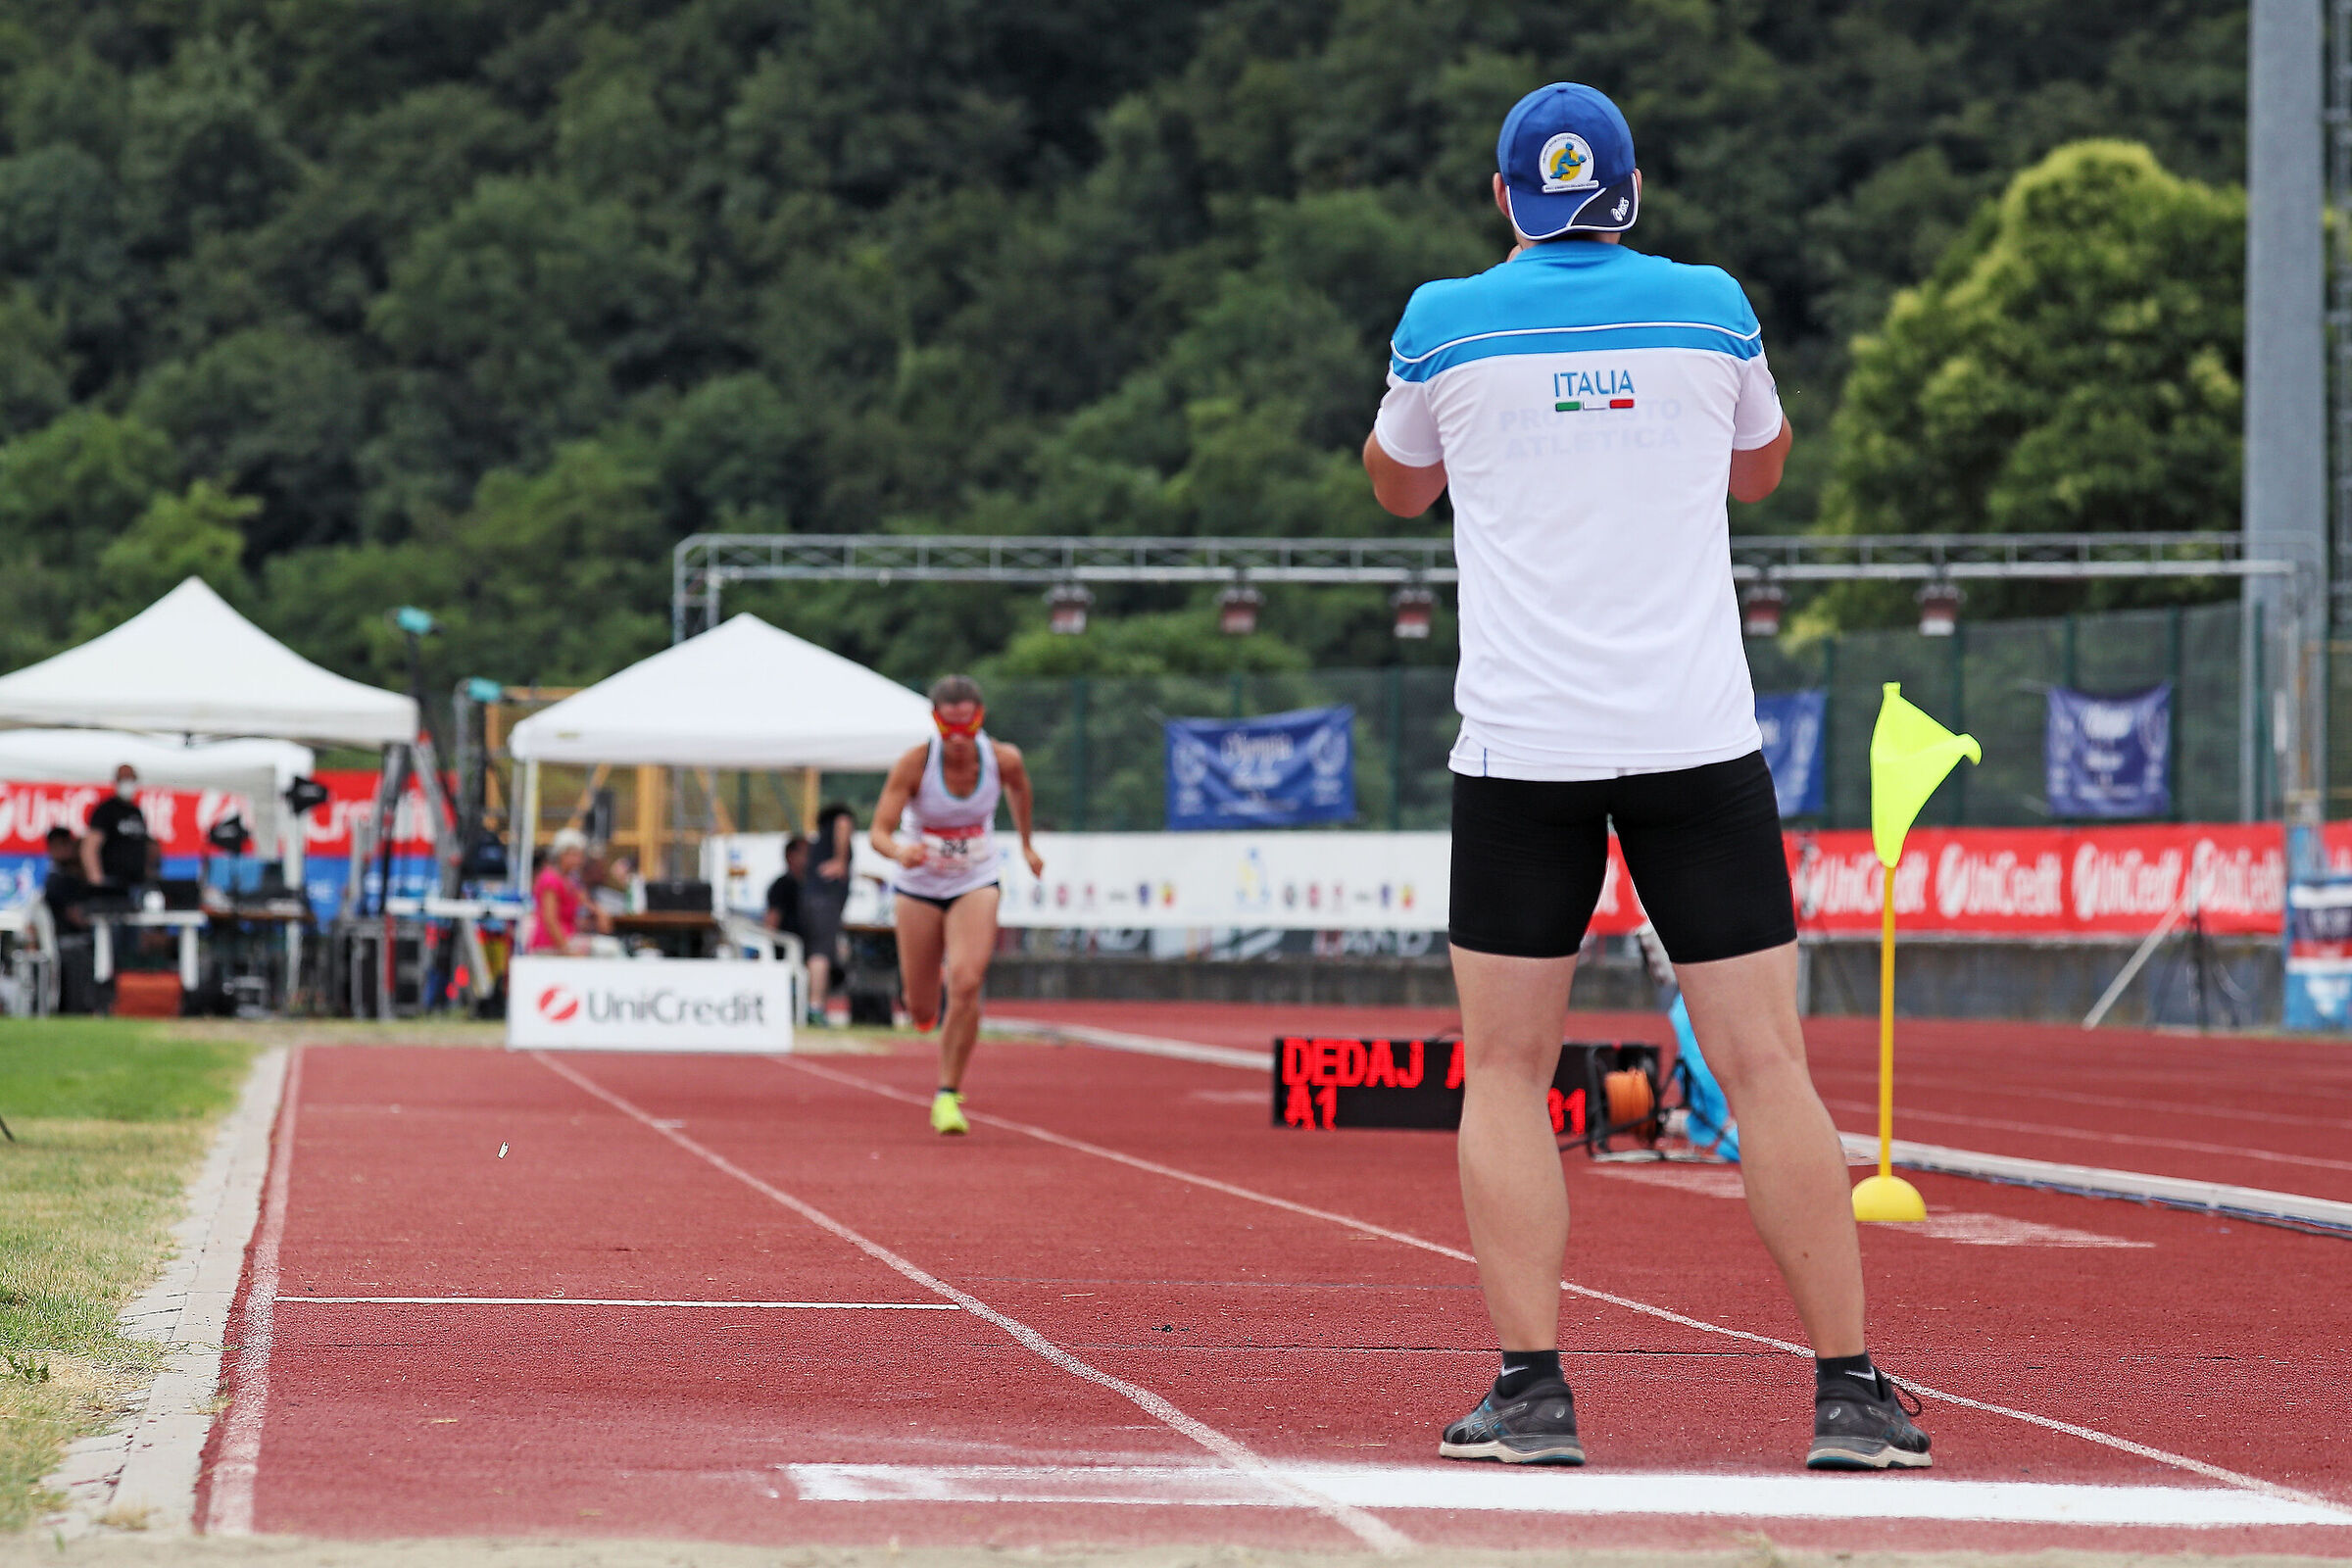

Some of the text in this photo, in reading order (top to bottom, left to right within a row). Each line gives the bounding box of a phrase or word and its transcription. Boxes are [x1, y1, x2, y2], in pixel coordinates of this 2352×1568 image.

[1553, 369, 1636, 398] ITALIA
[588, 988, 765, 1025] UniCredit
[1282, 1037, 1424, 1089] DEDAJ
[1284, 1082, 1337, 1132] A1
